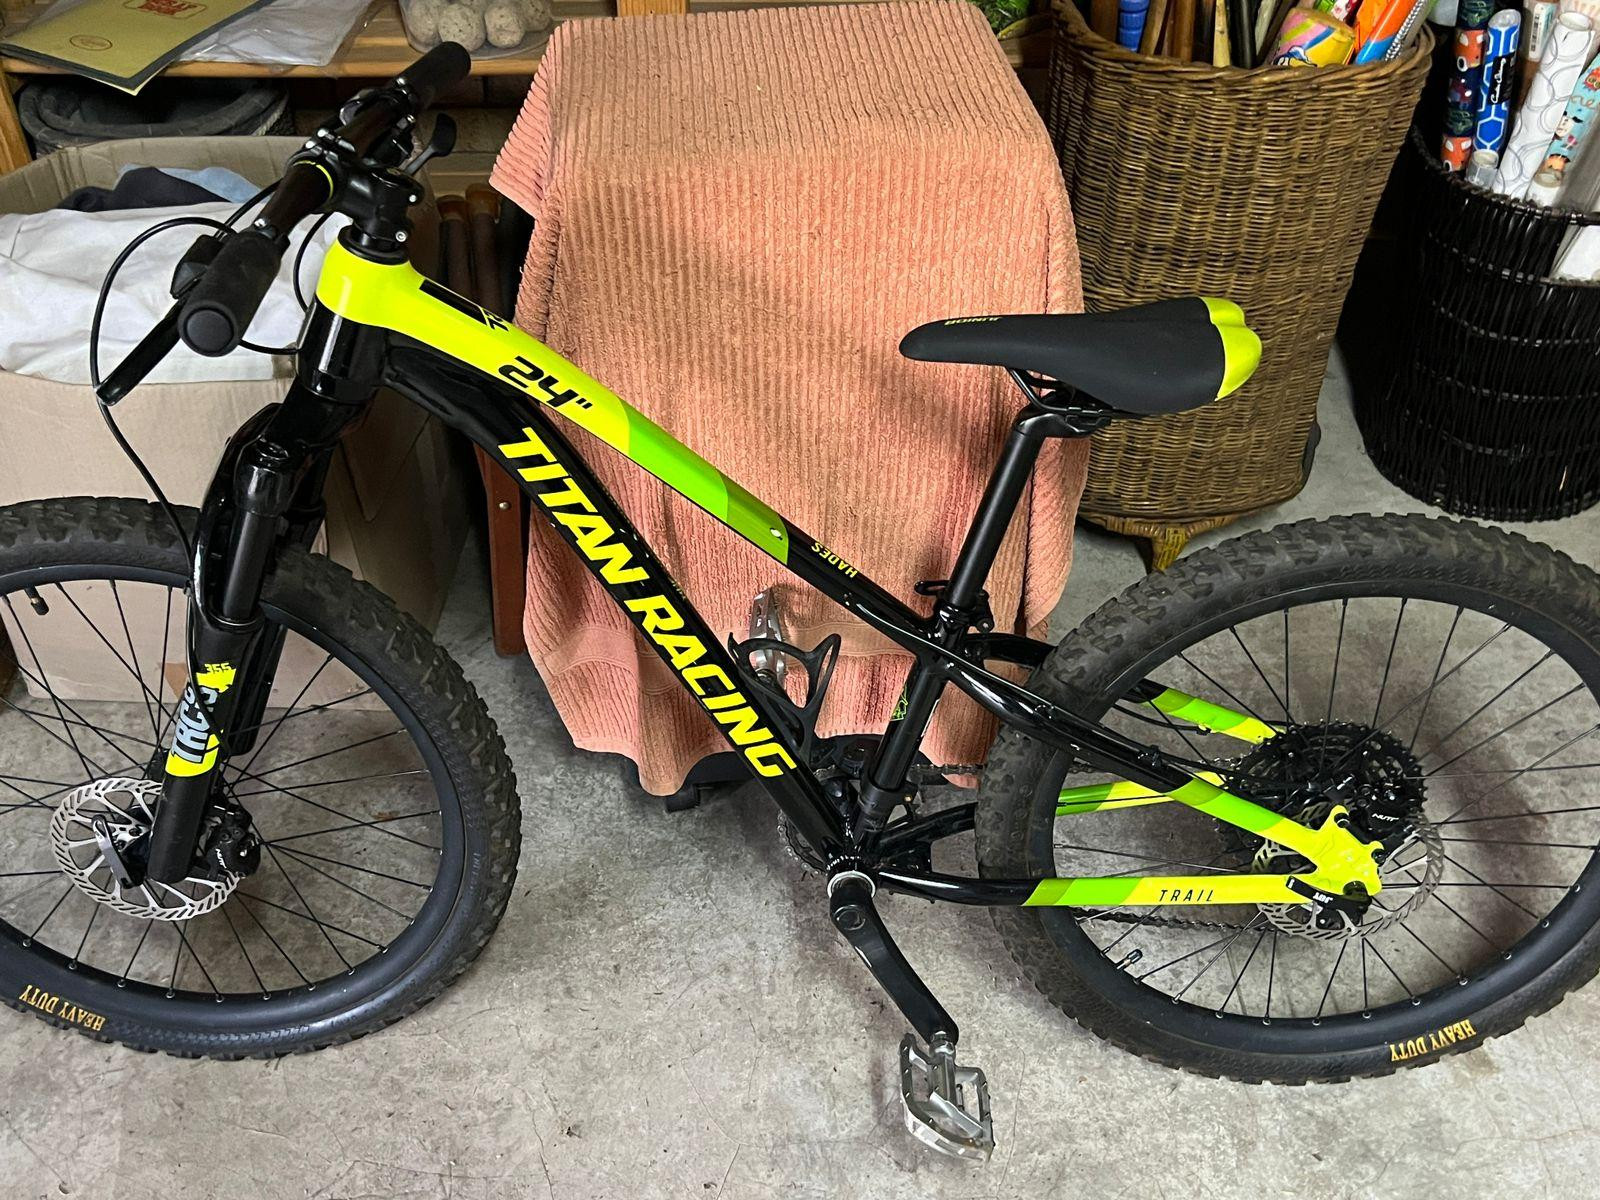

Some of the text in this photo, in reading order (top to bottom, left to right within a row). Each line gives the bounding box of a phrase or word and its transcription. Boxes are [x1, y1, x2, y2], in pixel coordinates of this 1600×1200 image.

[498, 355, 593, 409] 24"
[811, 542, 858, 578] HADES
[498, 427, 797, 777] TITAN RACING
[204, 662, 232, 674] 355
[1159, 889, 1214, 902] TRAIL
[19, 984, 106, 1032] HEAVY DUTY
[1389, 1019, 1477, 1062] HEAVY DUTY
